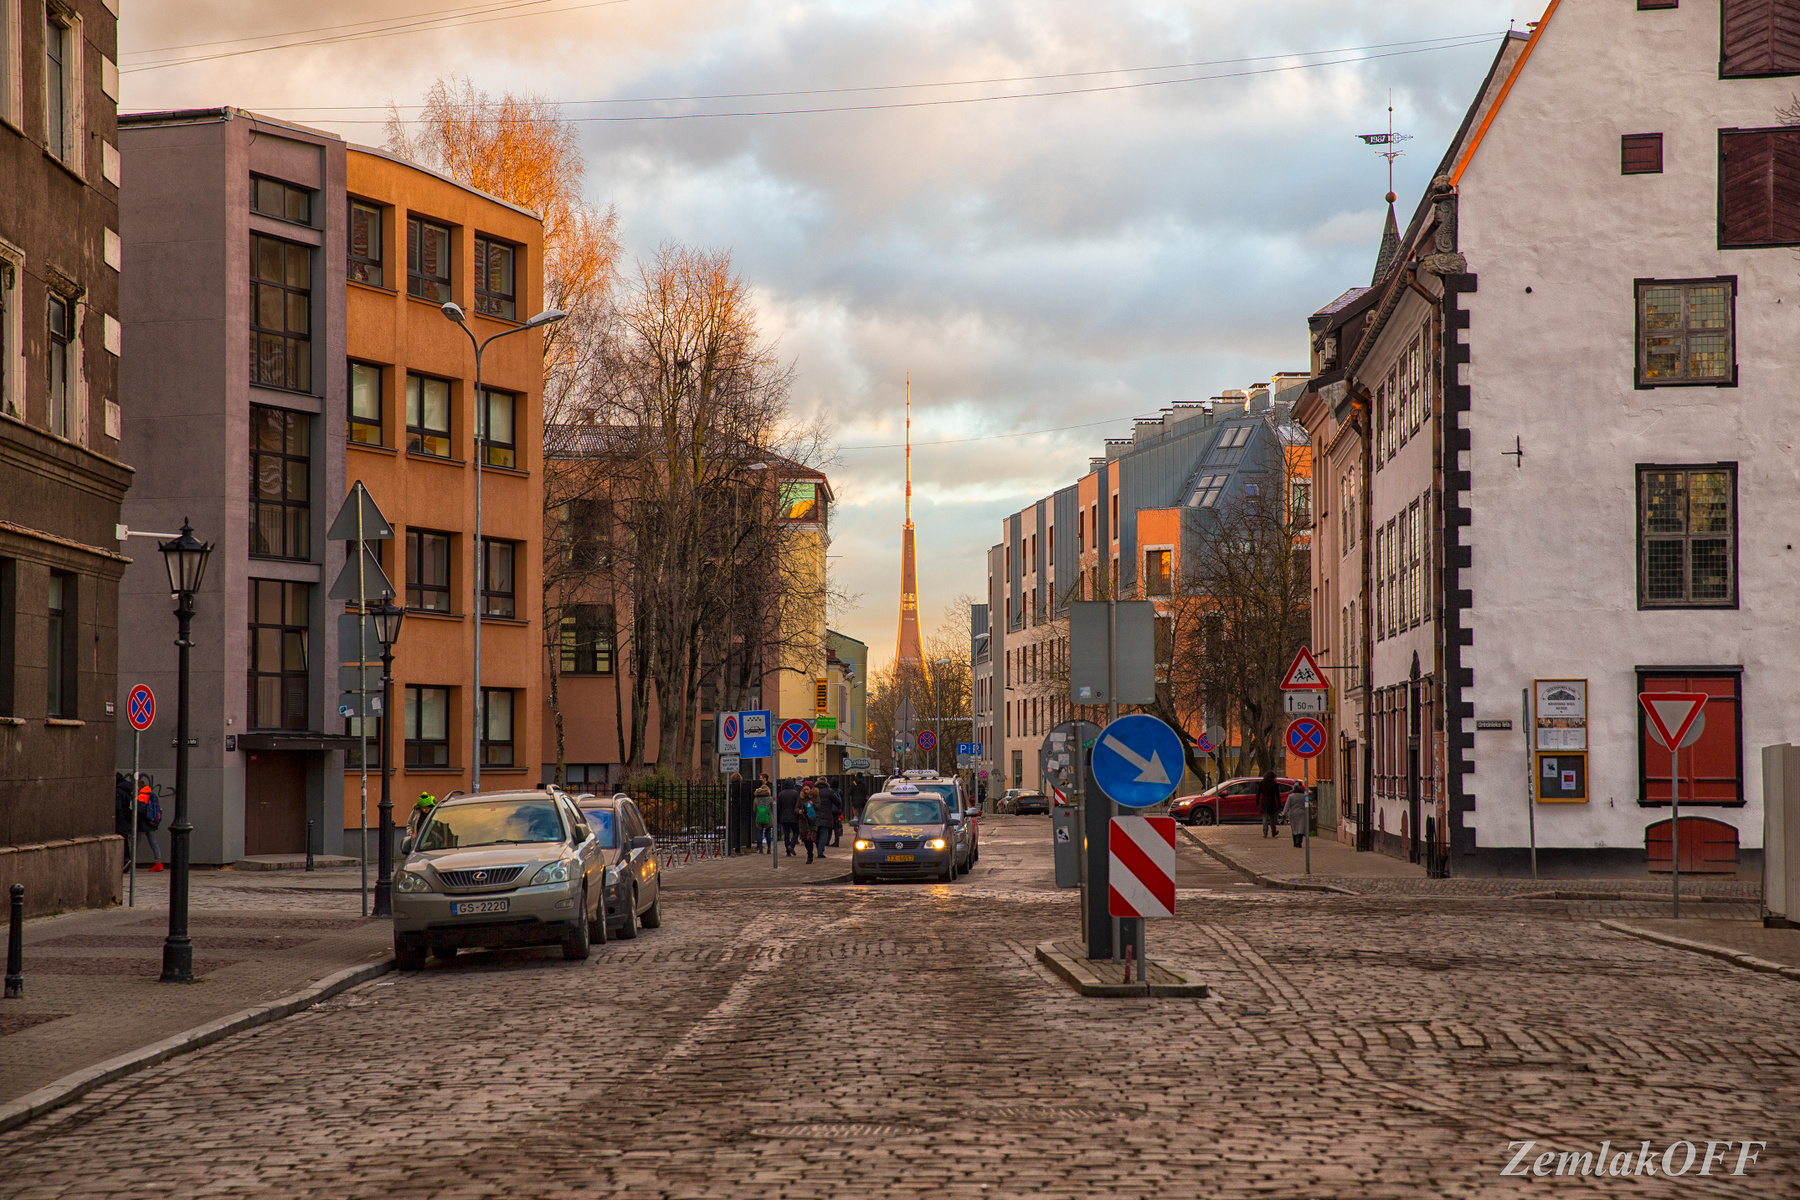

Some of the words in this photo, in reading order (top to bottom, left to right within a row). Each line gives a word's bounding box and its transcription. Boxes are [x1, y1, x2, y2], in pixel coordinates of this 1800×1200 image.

[1370, 135, 1385, 143] 1987
[817, 684, 827, 708] CLUB
[1297, 701, 1307, 710] 50
[724, 743, 737, 751] ZONA
[960, 744, 967, 754] P
[459, 901, 506, 913] GS-2220
